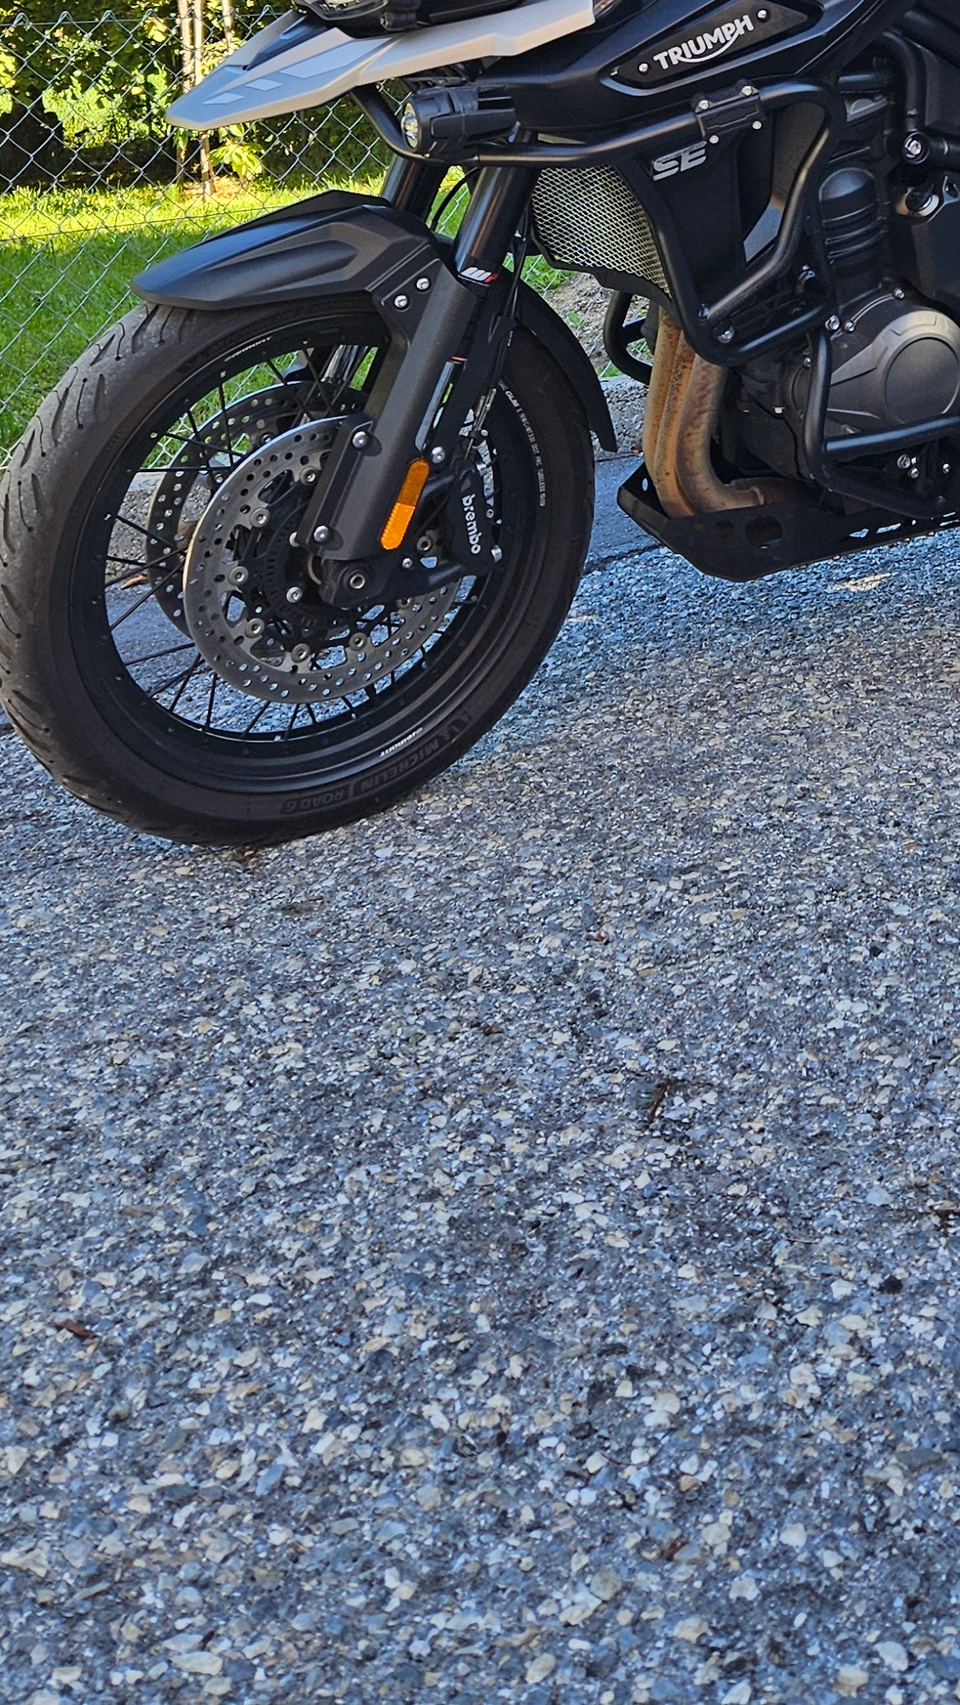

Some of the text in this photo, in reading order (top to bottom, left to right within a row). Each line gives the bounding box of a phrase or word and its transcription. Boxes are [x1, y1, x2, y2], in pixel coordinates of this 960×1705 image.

[652, 14, 754, 70] TRIUMPH
[652, 141, 708, 182] SE
[461, 493, 483, 554] brembo
[360, 739, 440, 791] MICHELIN
[300, 790, 345, 811] ROAD
